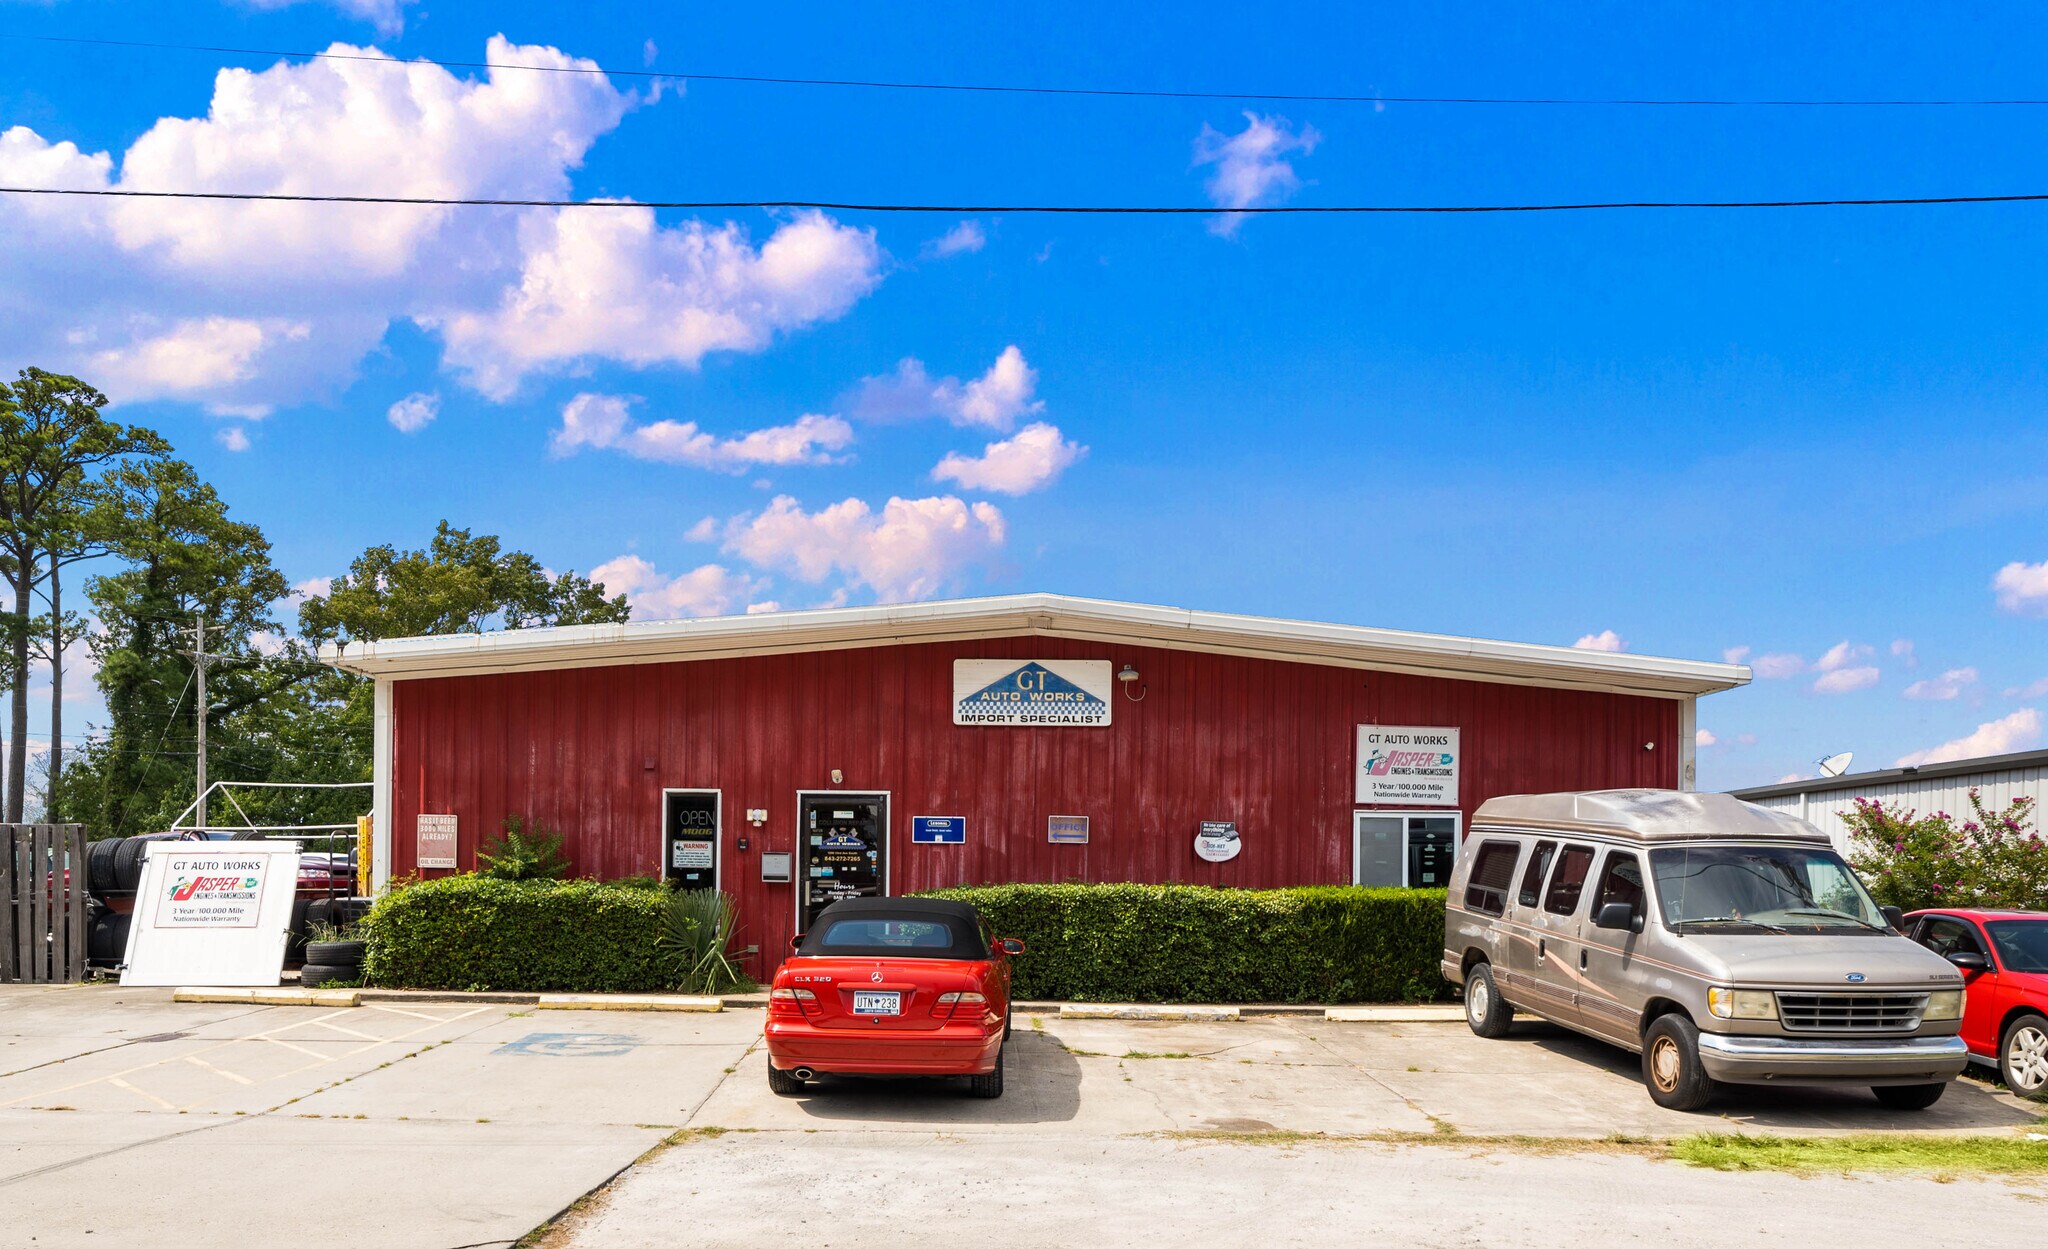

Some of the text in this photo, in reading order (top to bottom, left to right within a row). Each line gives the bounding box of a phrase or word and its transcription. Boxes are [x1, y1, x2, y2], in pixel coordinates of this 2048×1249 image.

[1017, 671, 1047, 691] GT
[980, 692, 1085, 701] AUTO WORKS
[961, 714, 1102, 723] IMPORT SPECIALIST
[1369, 734, 1448, 745] GT AUTO WORKS
[1371, 750, 1435, 776] JASPER
[1391, 767, 1411, 775] ENGINES
[1414, 768, 1453, 776] TRANSMISSIONS
[1411, 792, 1442, 800] Warranty
[439, 817, 456, 825] BEEN
[680, 810, 715, 825] OPEN
[1051, 823, 1086, 831] OFFICE
[421, 833, 453, 841] ALREADY?
[173, 861, 261, 870] GT AUTO WORKS
[173, 876, 240, 901] JASPER
[834, 881, 855, 890] Hours
[194, 891, 214, 900] ENGINES
[217, 891, 256, 899] TRANSMISSIONS
[857, 997, 897, 1009] UTN 238
